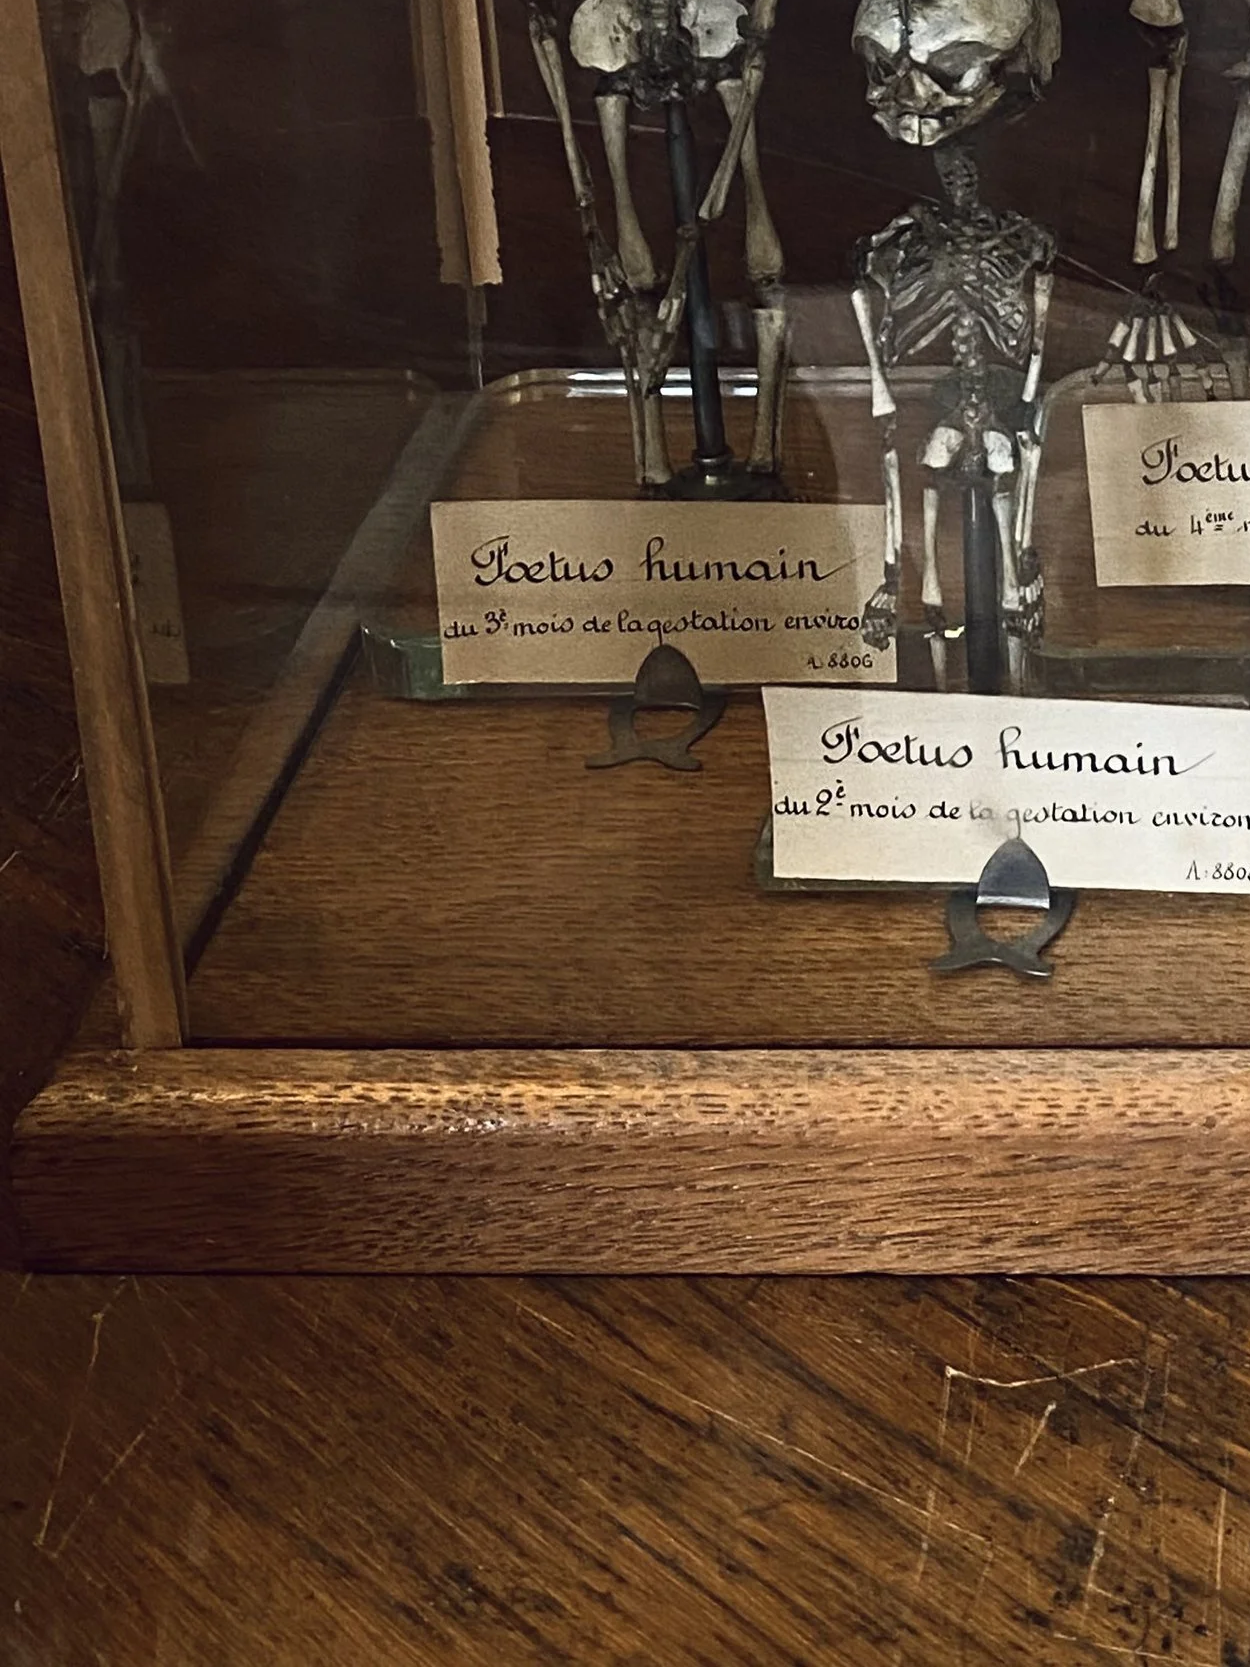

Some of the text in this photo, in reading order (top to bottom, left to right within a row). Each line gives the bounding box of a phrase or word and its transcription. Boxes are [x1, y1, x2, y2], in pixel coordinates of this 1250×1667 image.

[1135, 520, 1177, 537] du
[640, 536, 868, 583] humain
[443, 620, 479, 640] du
[513, 613, 574, 637] mois
[582, 615, 611, 633] de
[617, 609, 644, 633] la
[646, 607, 776, 645] gestation
[784, 607, 862, 631] enviro
[997, 726, 1216, 777] humain
[774, 795, 812, 817] du
[850, 796, 917, 819] mois
[926, 800, 962, 820] de
[1006, 801, 1140, 840] gestation
